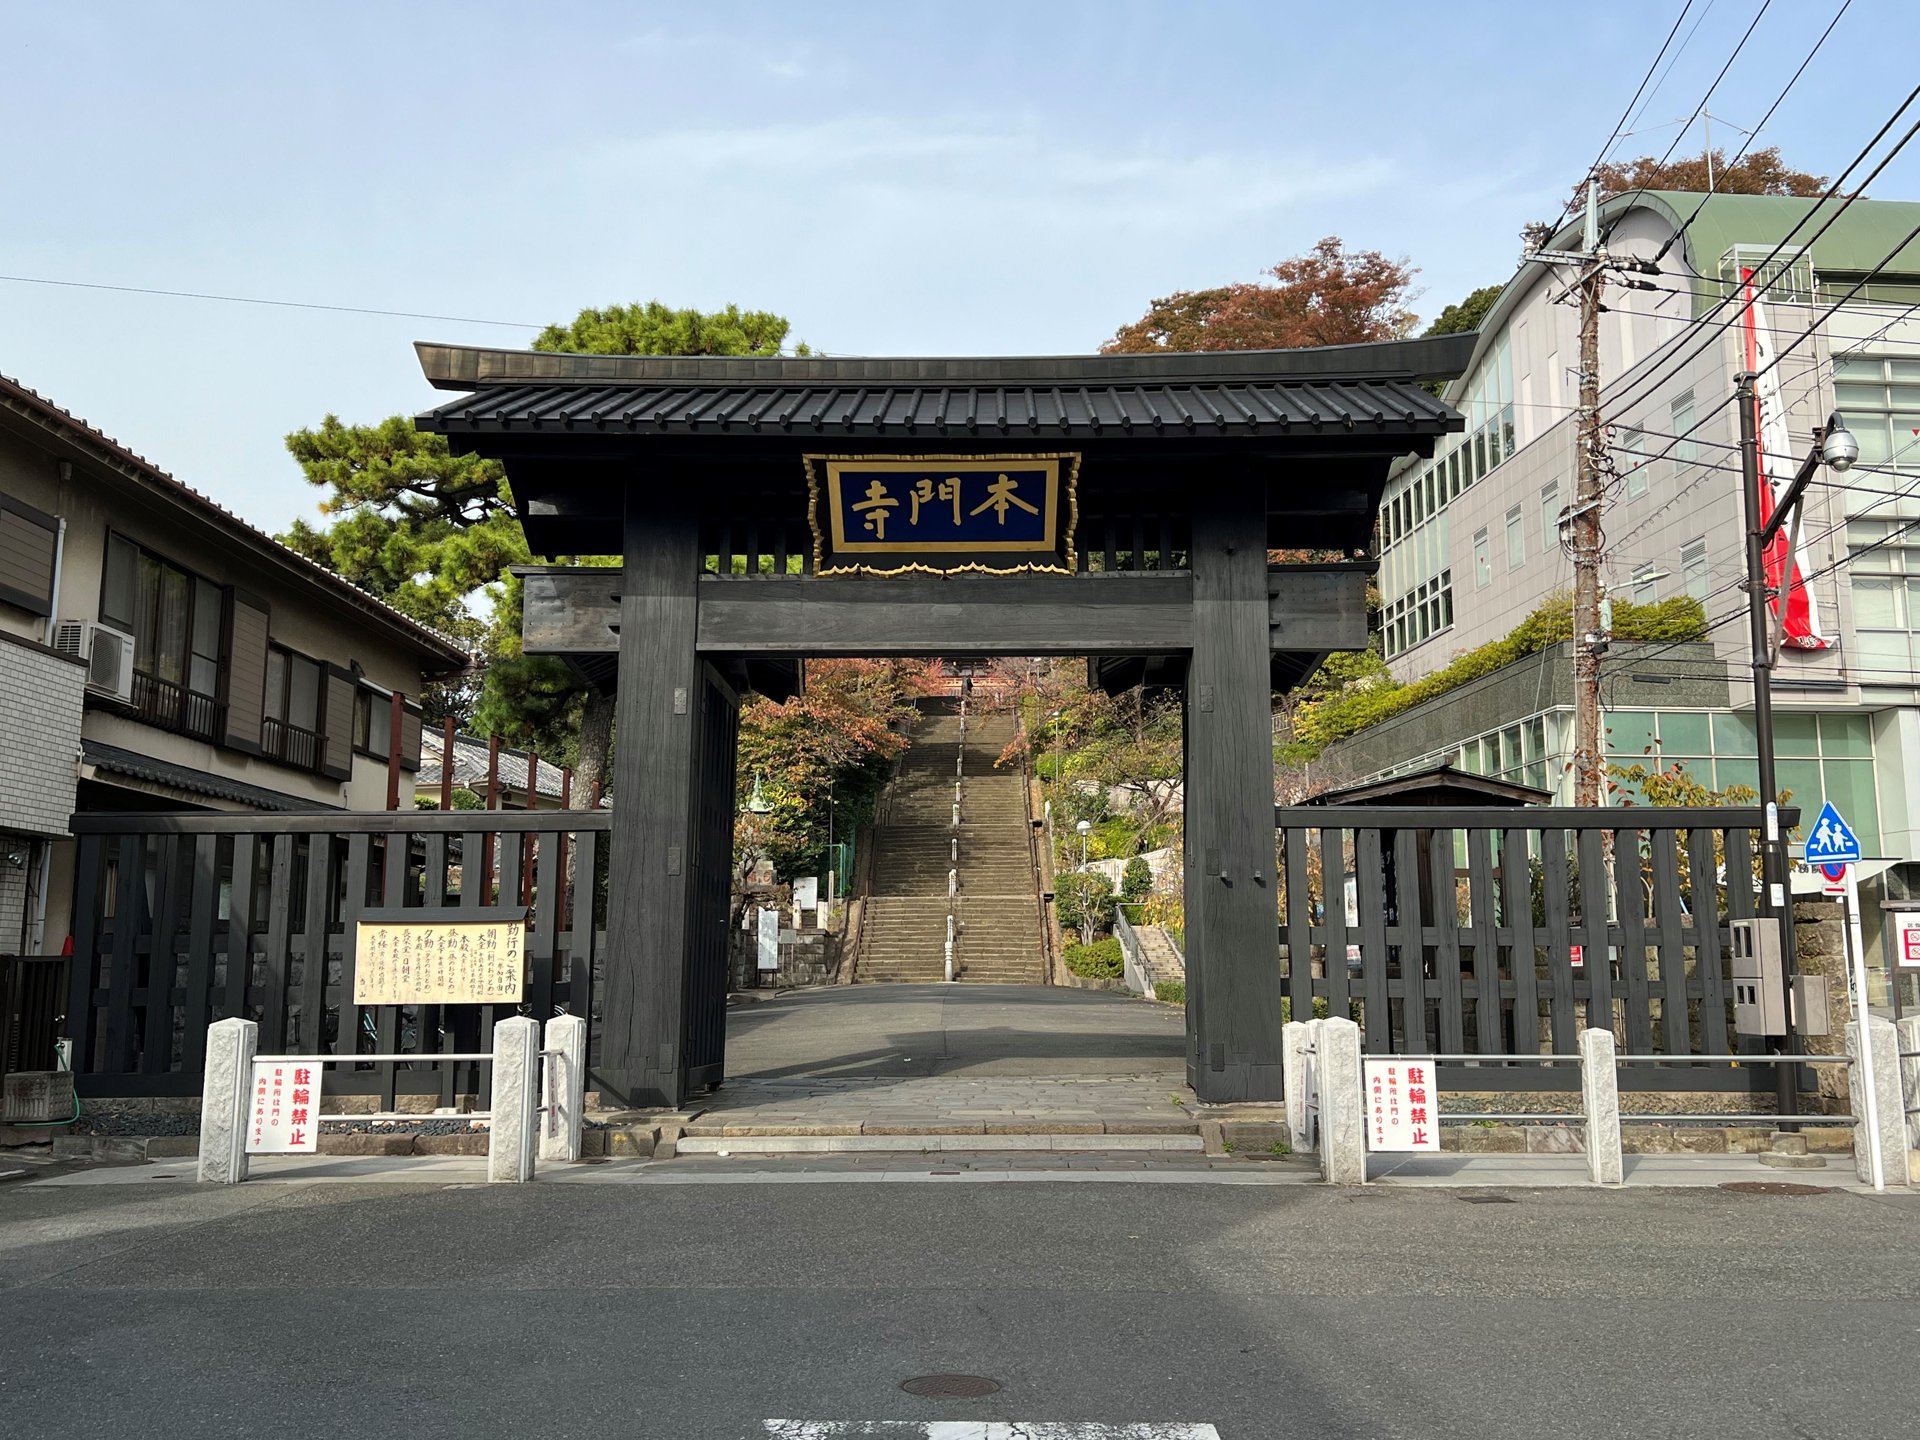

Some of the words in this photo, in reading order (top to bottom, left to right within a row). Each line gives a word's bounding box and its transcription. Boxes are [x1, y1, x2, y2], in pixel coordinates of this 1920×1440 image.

[504, 922, 519, 995] 勤行のご案内
[253, 1077, 267, 1145] 内側にあります
[271, 1068, 283, 1127] 駐輪所は門の
[289, 1068, 311, 1145] 駐輪禁止
[1373, 1076, 1384, 1144] 内側にあります
[1388, 1067, 1399, 1125] 駐輪所は門の
[1407, 1067, 1429, 1145] 駐輪禁止
